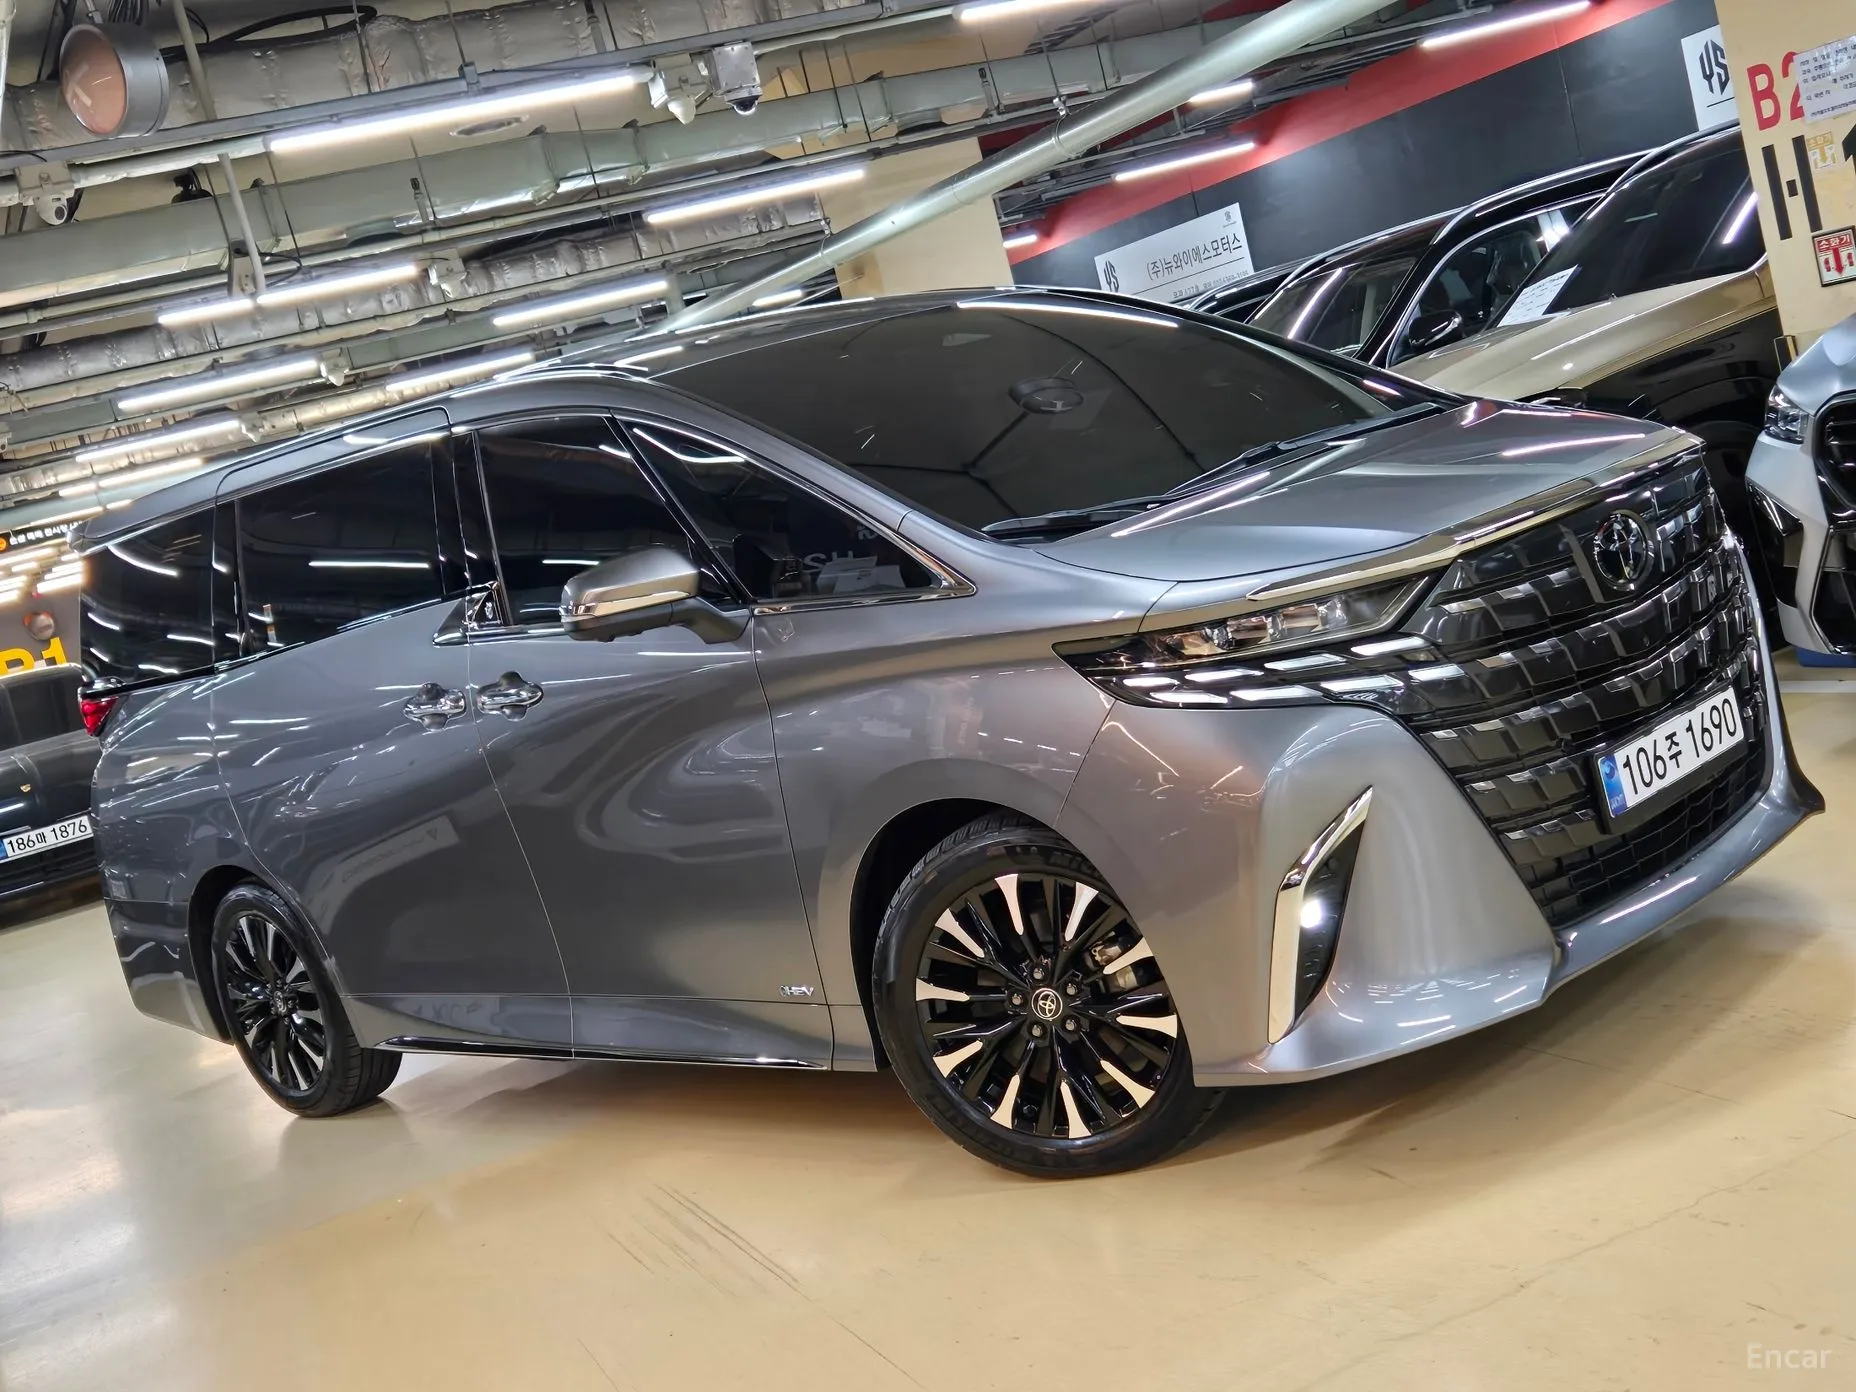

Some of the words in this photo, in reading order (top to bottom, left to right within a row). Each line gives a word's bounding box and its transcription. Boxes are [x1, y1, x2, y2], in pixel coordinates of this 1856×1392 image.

[1146, 232, 1243, 282] (주)뉴와이에스모터스
[1819, 233, 1851, 250] 소화기
[1622, 731, 1682, 795] 106주
[1685, 698, 1738, 758] 1690
[7, 831, 47, 853] 186마
[50, 819, 88, 841] 1876
